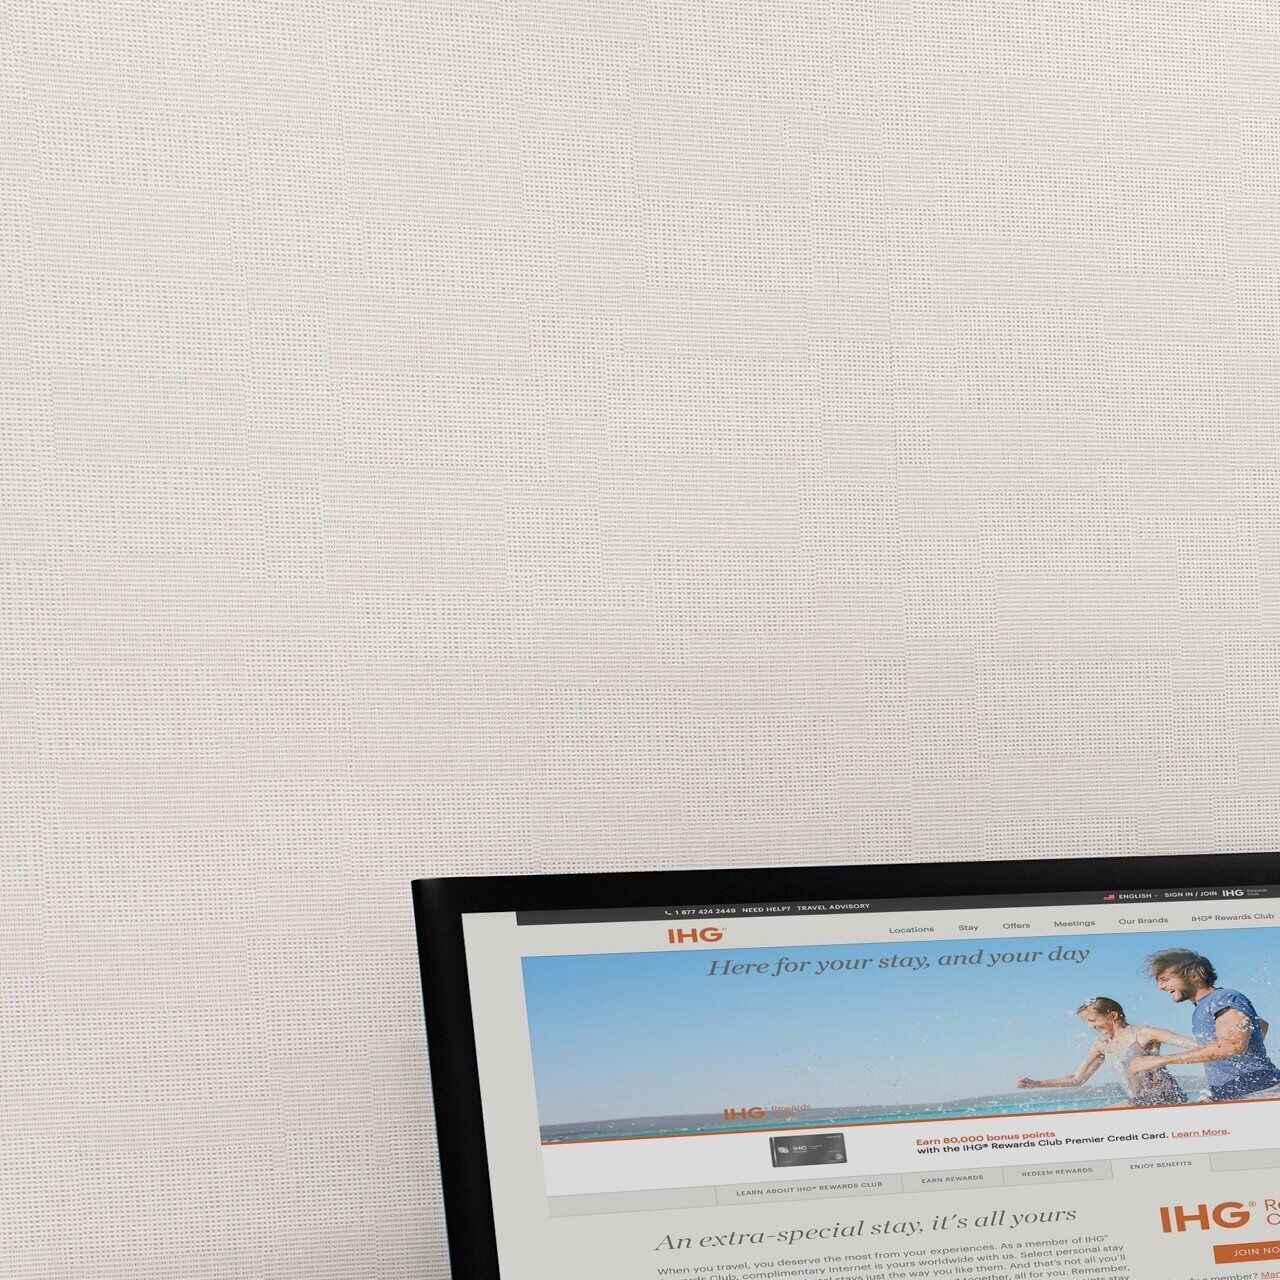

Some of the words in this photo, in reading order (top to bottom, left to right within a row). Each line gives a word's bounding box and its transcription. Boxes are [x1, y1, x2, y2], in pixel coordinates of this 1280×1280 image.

[1137, 916, 1169, 924] Brands
[1214, 913, 1252, 921] Rewards
[1253, 912, 1275, 920] Club
[957, 924, 979, 932] Stay
[1002, 922, 1032, 930] Offers
[1053, 920, 1096, 928] Meetings
[888, 926, 935, 934] Locations
[704, 959, 770, 977] Here
[770, 954, 812, 977] for
[814, 958, 874, 975] your
[877, 952, 931, 971] stay,
[937, 949, 985, 967] and
[986, 945, 1044, 968] your
[1047, 943, 1091, 964] day
[916, 1138, 941, 1146] Earn
[942, 1135, 984, 1145] 80,000
[986, 1134, 1020, 1142] bonus
[1021, 1131, 1056, 1140] points
[916, 1146, 941, 1155] with
[942, 1145, 961, 1153] the
[990, 1140, 1036, 1150] Rewards
[1037, 1138, 1063, 1147] Club
[1064, 1136, 1105, 1145] Premier
[1106, 1133, 1139, 1142] Credit
[1141, 1131, 1169, 1140] Card.
[1156, 1160, 1193, 1168] BENEFITS
[1021, 1169, 1054, 1177] REDEEM
[1054, 1167, 1094, 1175] REWARDS
[944, 1174, 984, 1183] REWARDS
[736, 1189, 764, 1197] LEARN
[765, 1187, 795, 1195] ABOUT
[818, 1182, 859, 1191] REWARDS
[654, 1234, 692, 1251] An
[699, 1219, 865, 1248] extra-special
[870, 1220, 924, 1237] stay,
[932, 1213, 968, 1231] it's
[974, 1209, 1006, 1228] all
[1009, 1210, 1077, 1229] yours
[656, 1267, 691, 1276] When
[692, 1266, 714, 1274] you
[716, 1261, 751, 1271] travel,
[753, 1261, 775, 1270] you
[776, 1257, 821, 1267] deserve
[823, 1255, 842, 1263] the
[844, 1253, 872, 1261] most
[874, 1251, 901, 1260] from
[902, 1249, 927, 1259] your
[929, 1244, 997, 1256] experiences.
[1000, 1242, 1014, 1250] As
[1024, 1238, 1069, 1248] member
[1071, 1236, 1083, 1245] of
[1233, 1248, 1259, 1257] JOIN
[741, 1268, 826, 1280] complimentary
[828, 1263, 872, 1273] Internet
[874, 1262, 884, 1270] is
[885, 1261, 916, 1270] yours
[917, 1255, 974, 1267] worldwide
[976, 1253, 1000, 1262] with
[1019, 1250, 1053, 1259] Select
[1055, 1245, 1101, 1257] personal
[1102, 1245, 1124, 1253] stay
